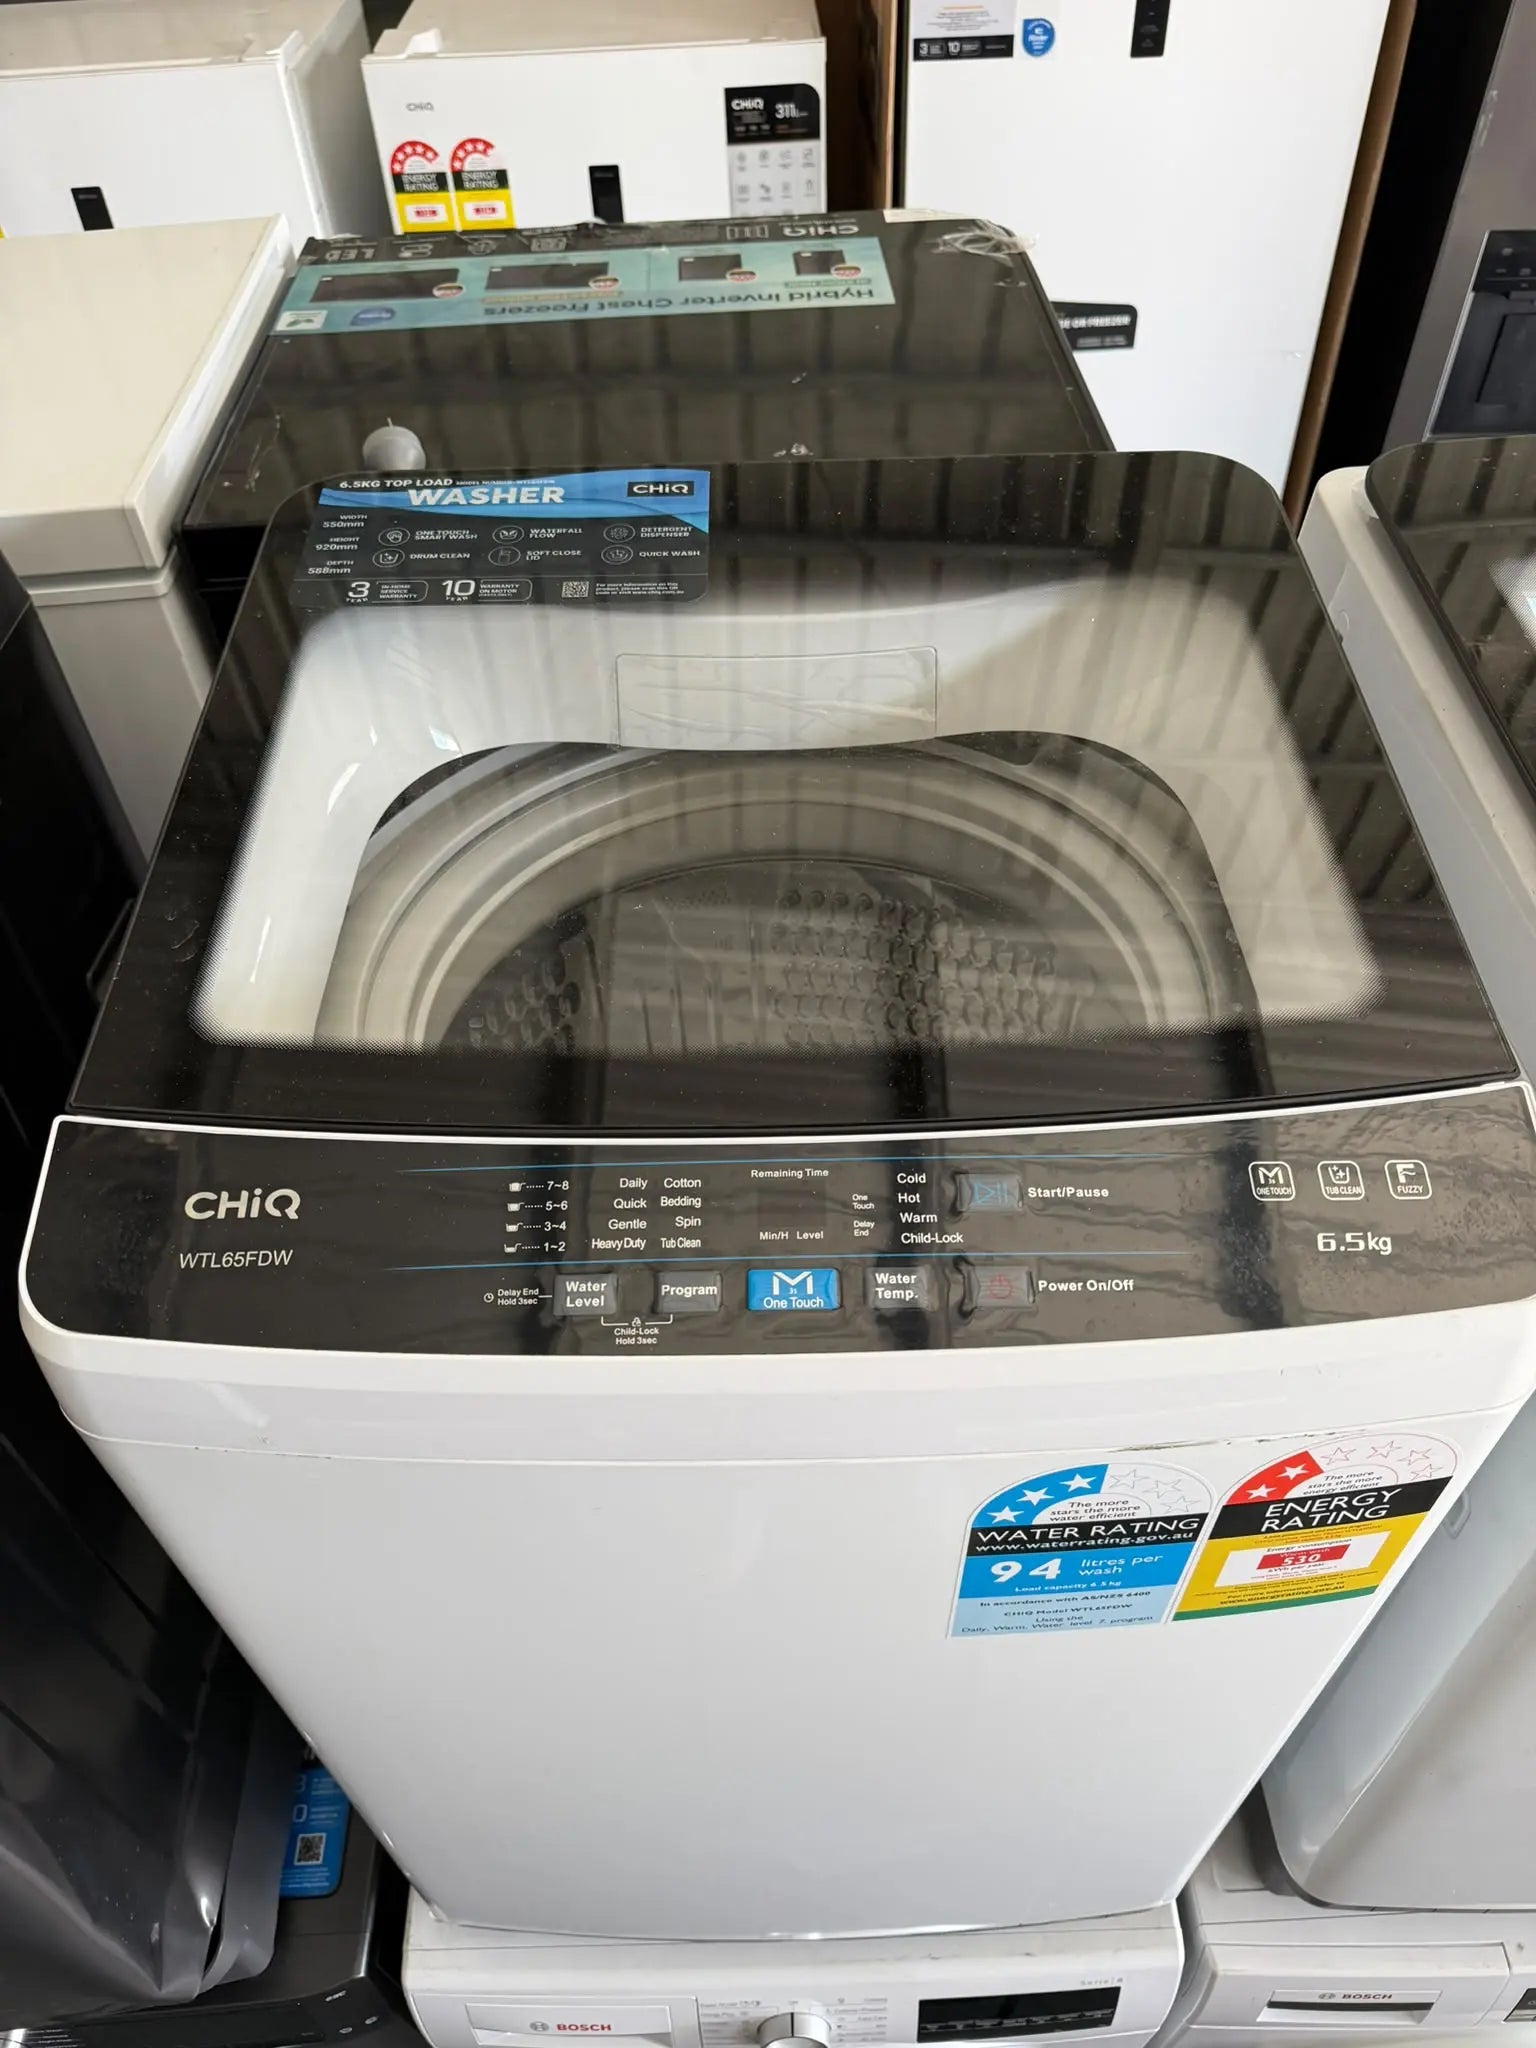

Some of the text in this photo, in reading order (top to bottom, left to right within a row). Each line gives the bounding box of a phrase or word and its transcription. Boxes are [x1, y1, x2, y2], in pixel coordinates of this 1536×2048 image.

[677, 292, 780, 307] Inverter
[788, 288, 874, 302] Hybrid
[483, 303, 589, 318] Freezers
[597, 298, 673, 312] Chest
[339, 480, 381, 489] 6.5KG
[386, 479, 413, 488] TOP
[416, 478, 453, 487] LOAD
[633, 483, 689, 494] CHiQ
[408, 486, 565, 506] WASHER
[316, 543, 358, 551] 920mm
[308, 567, 351, 575] 588mm
[348, 581, 371, 598] 3
[441, 580, 476, 596] 10
[751, 1168, 829, 1179] Remaining Time
[897, 1173, 927, 1184] Cold
[619, 1178, 648, 1190] Daily
[663, 1177, 702, 1189] Cotton
[1027, 1187, 1109, 1198] Start/Pause
[1256, 1186, 1292, 1195] ONE TOUCH
[1325, 1186, 1362, 1195] TUB CLEAN
[1397, 1185, 1424, 1194] FUZZY
[613, 1197, 647, 1209] Quick
[660, 1196, 702, 1208] Bedding
[852, 1193, 868, 1201] One
[898, 1193, 921, 1204] Hot
[185, 1188, 301, 1220] CHiQ
[852, 1202, 874, 1210] Touch
[675, 1216, 702, 1229] Spin
[899, 1213, 938, 1223] Warm
[608, 1219, 647, 1230] Gentle
[853, 1220, 875, 1229] Delay
[759, 1230, 824, 1241] Min/H Level
[901, 1232, 964, 1244] Child-Lock
[591, 1238, 647, 1251] Heavy Duty
[661, 1237, 702, 1248] Tub Clean
[1317, 1232, 1392, 1255] 6.5kg
[180, 1249, 293, 1269] WTL65FDW
[875, 1272, 917, 1284] Water
[566, 1280, 607, 1292] Water
[661, 1284, 718, 1298] Program
[1038, 1279, 1134, 1291] Power On/Off
[497, 1288, 539, 1298] Delay End
[875, 1287, 919, 1301] Temp.
[497, 1297, 538, 1306] Hold 3sec
[566, 1296, 605, 1307] Level
[763, 1296, 824, 1308] One Touch
[614, 1327, 659, 1336] Child-Lock
[616, 1337, 657, 1345] Hold 3sec
[1303, 1482, 1380, 1495] energy efficient
[1069, 1501, 1092, 1509] The
[1265, 1488, 1402, 1518] ENERGY
[1089, 1511, 1136, 1520] efficient
[1260, 1504, 1391, 1532] RATING
[976, 1518, 1200, 1543] WATER RATING
[976, 1531, 1193, 1552] www.waterrating.gov.au
[1081, 1555, 1164, 1568] litres per
[1280, 1554, 1321, 1566] 530
[1079, 1566, 1122, 1576] wash
[1044, 1582, 1088, 1592] capacity
[1110, 1616, 1153, 1624] program
[556, 2023, 612, 2032] BOSCH
